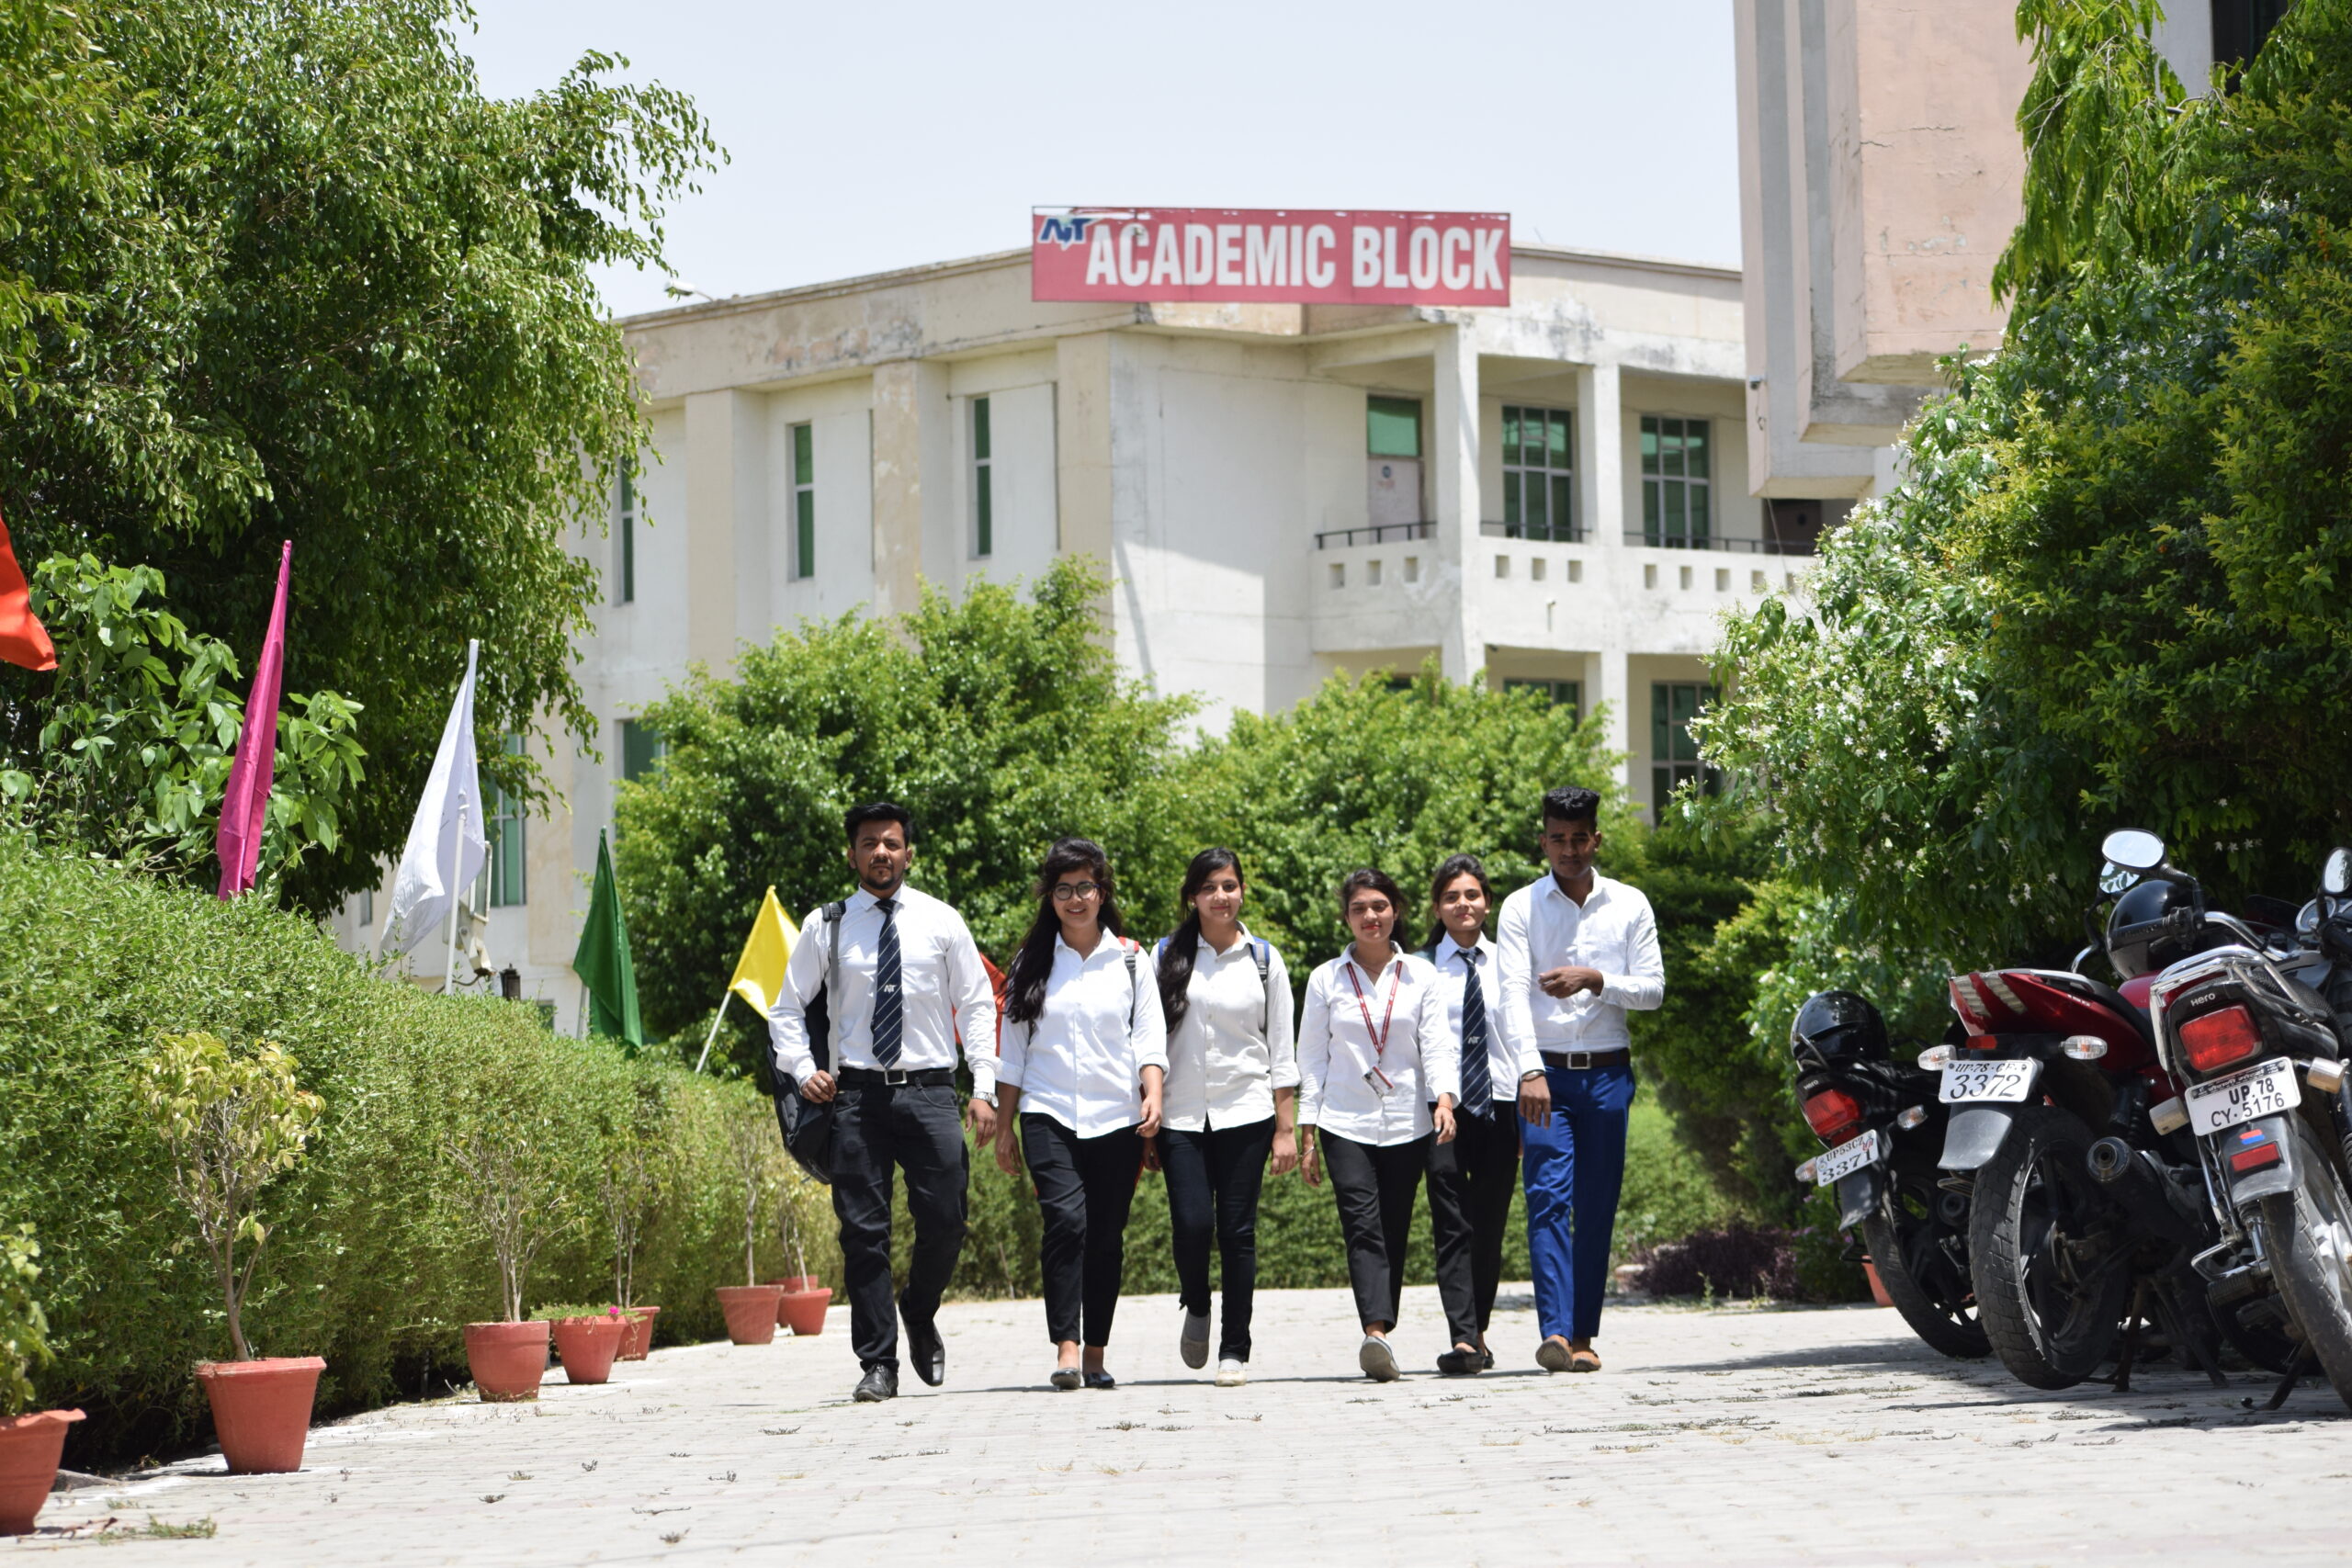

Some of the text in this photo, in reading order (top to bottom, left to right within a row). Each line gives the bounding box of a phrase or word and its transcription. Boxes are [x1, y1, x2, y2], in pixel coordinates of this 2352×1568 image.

[1085, 223, 1505, 291] ACADEMIC BLOCK
[2190, 992, 2216, 1007] Hero
[1950, 1074, 2021, 1100] 3372
[1823, 1148, 1871, 1183] 3371
